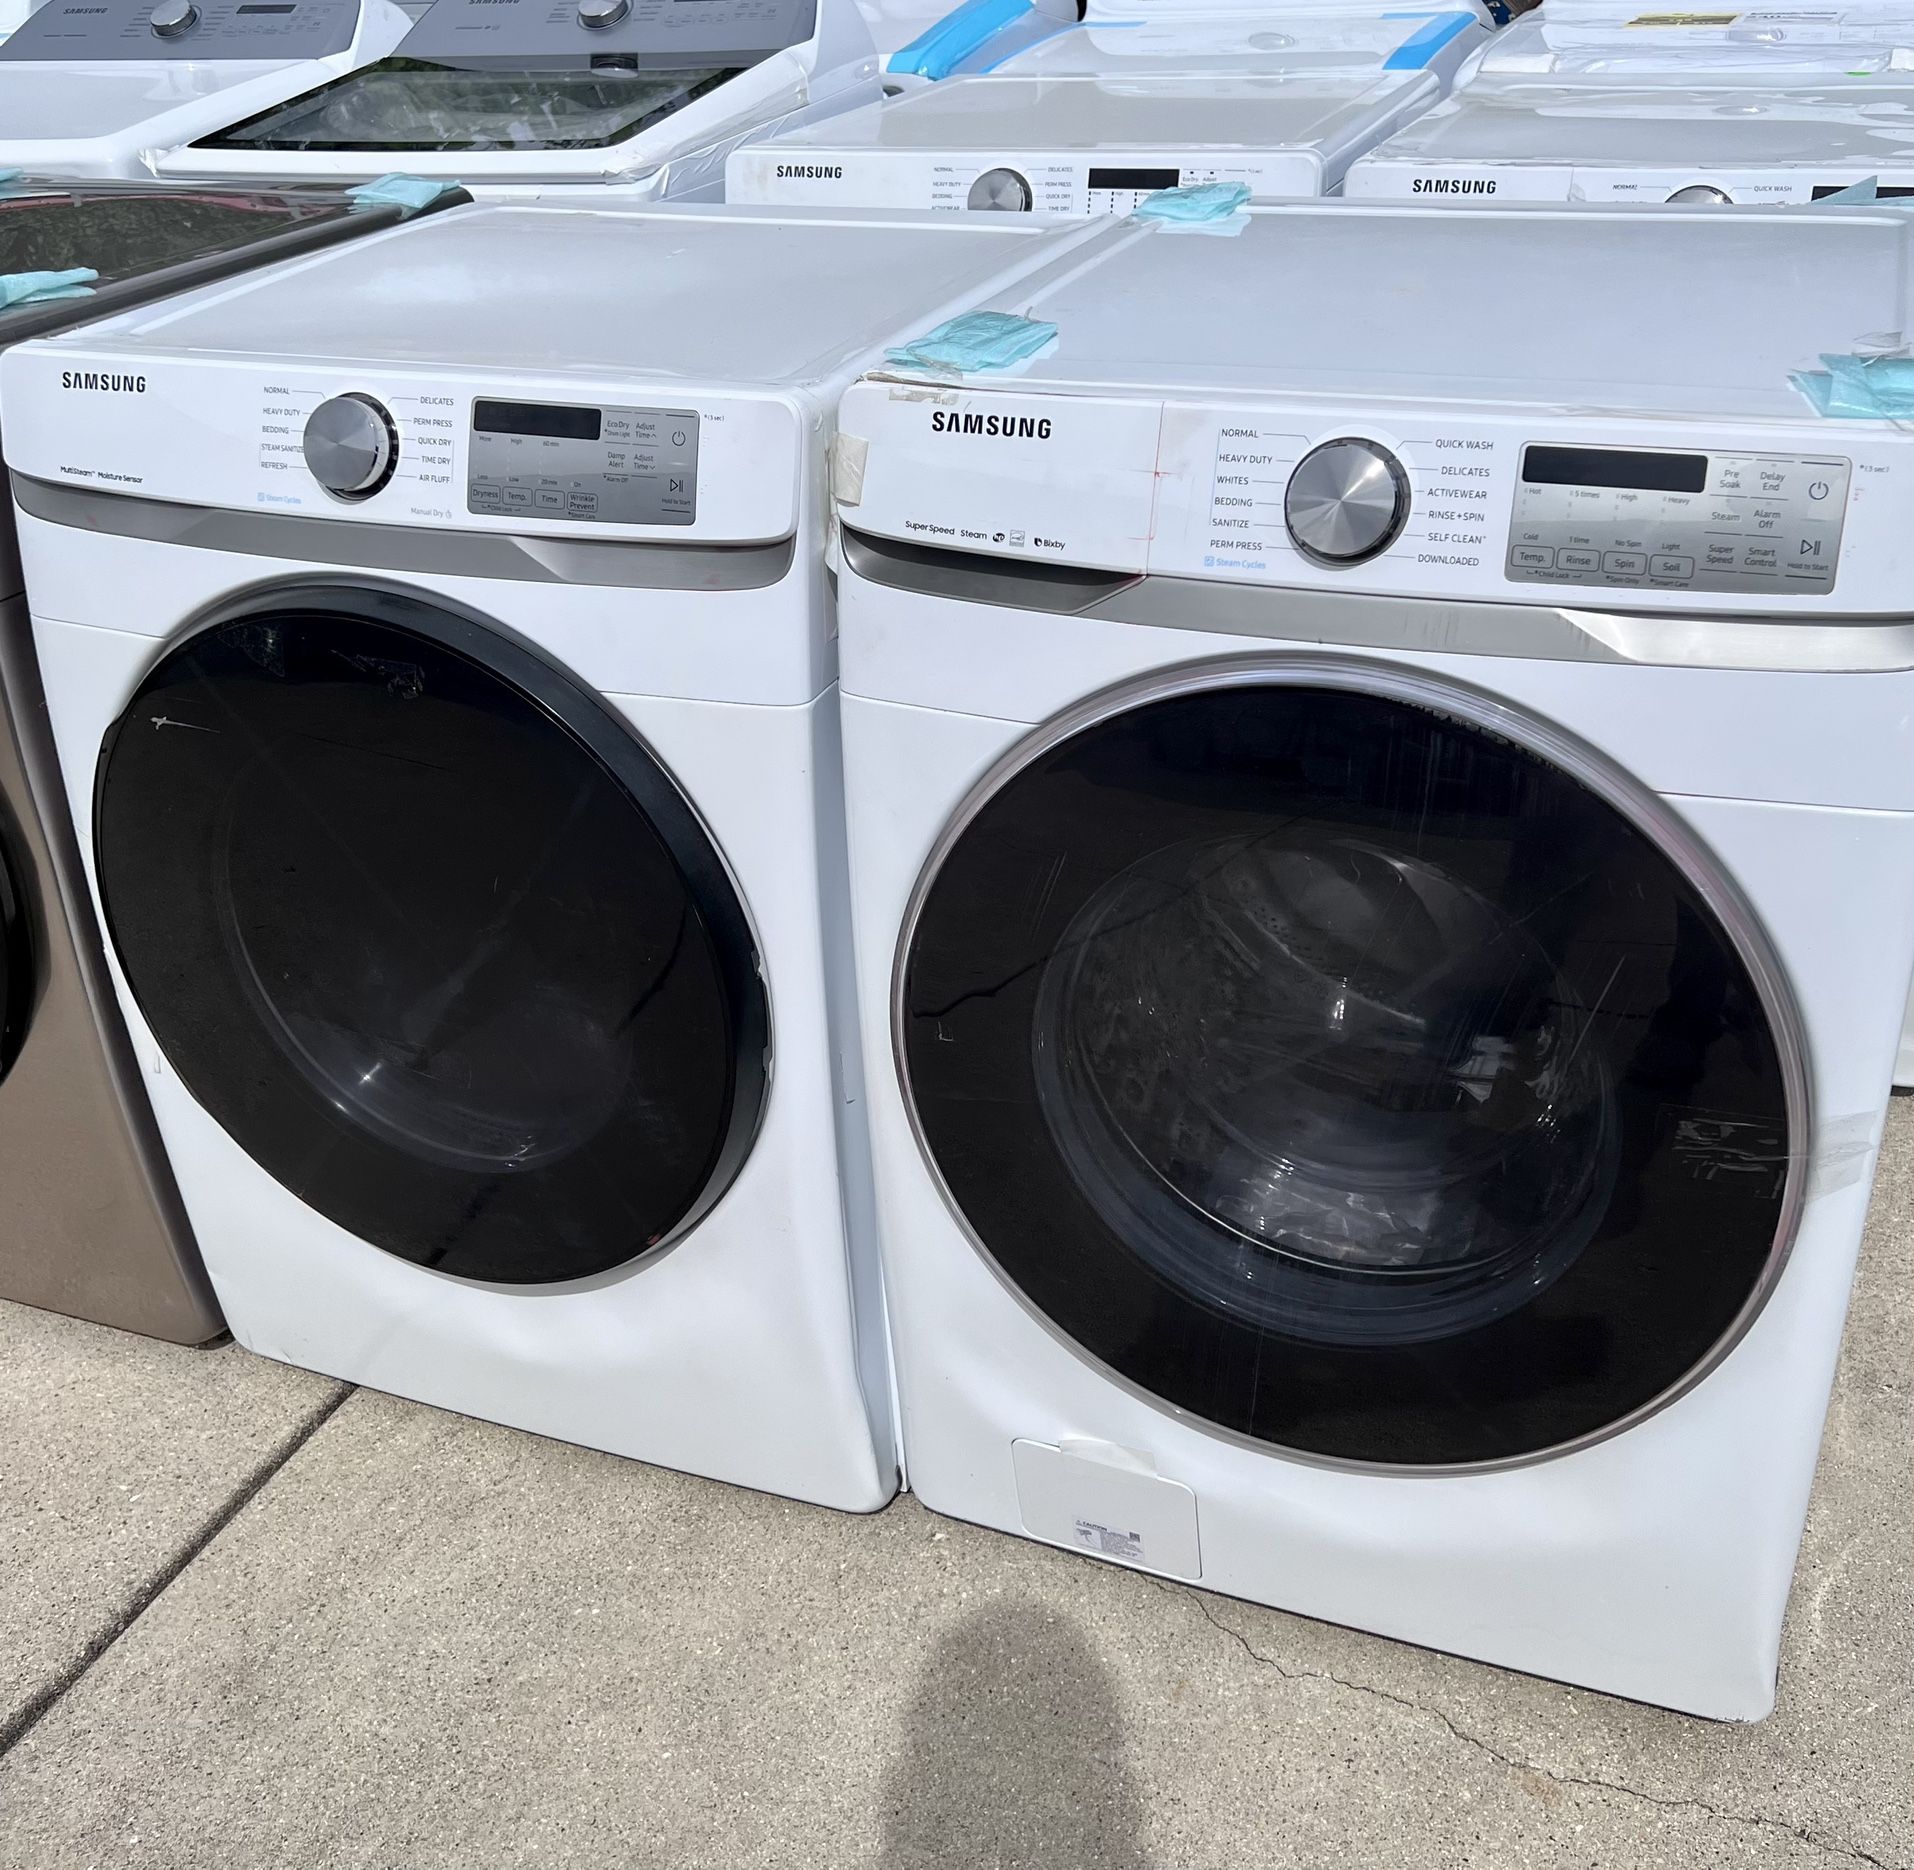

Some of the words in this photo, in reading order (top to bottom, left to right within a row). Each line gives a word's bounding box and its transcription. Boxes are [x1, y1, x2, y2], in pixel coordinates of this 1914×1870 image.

[776, 165, 843, 179] SAMSUNG
[1412, 179, 1496, 194] SAMSUNG
[62, 371, 146, 393] SAMSUNG
[420, 396, 454, 406] DELICATES
[414, 418, 431, 426] PERM
[433, 419, 452, 428] PRESS
[636, 422, 655, 432] Adjust
[932, 411, 1051, 439] SAMSUNG
[262, 425, 289, 434] BEDDING
[1221, 429, 1259, 438] NORMAL
[635, 431, 650, 439] Time
[418, 437, 437, 446] QUICK
[438, 438, 451, 446] DRY
[1435, 439, 1464, 448] QUICK
[1466, 441, 1494, 450] WASH
[261, 443, 280, 451] STEAM
[421, 456, 436, 464] TIME
[437, 457, 451, 465] DRY
[608, 452, 625, 460] Damp
[634, 454, 654, 462] Adjust
[1219, 454, 1248, 463] HEAVY
[1249, 455, 1273, 464] DUTY
[261, 461, 288, 470] REFRESH
[608, 460, 624, 468] Alert
[634, 462, 649, 470] Time
[1441, 466, 1490, 477] DELICATES
[1724, 470, 1739, 478] Pre
[98, 471, 122, 481] Moisture
[123, 475, 143, 484] Sensor
[419, 474, 430, 482] AIR
[431, 476, 450, 484] FLUFF
[1217, 476, 1249, 485] WHITES
[1760, 472, 1786, 483] Delay
[1720, 480, 1741, 488] Soak
[1763, 482, 1780, 491] End
[473, 489, 498, 499] Dryness
[508, 492, 526, 501] Temp.
[541, 494, 558, 503] Time
[570, 494, 595, 502] Wrinkle
[1427, 488, 1487, 499] ACTIVEWEAR
[1580, 491, 1600, 499] times
[1621, 493, 1638, 501] High
[1214, 497, 1253, 507] BEDDING
[1668, 496, 1690, 505] Heavy
[569, 502, 595, 510] Prevent
[411, 507, 432, 516] Manual
[433, 509, 443, 519] Dry
[1428, 511, 1455, 520] RINSE
[1463, 512, 1484, 521] SPIN
[1712, 512, 1741, 522] Steam
[1754, 510, 1781, 519] Alarm
[1212, 518, 1249, 528] SANITIZE
[1759, 520, 1774, 528] Off
[960, 529, 987, 540] Steam
[1044, 539, 1065, 550] Bixby
[1428, 533, 1449, 541] SELF
[1210, 540, 1233, 549] PERM
[1236, 541, 1262, 550] PRESS
[1709, 545, 1735, 554] Super
[1520, 551, 1546, 563] Temp.
[1748, 547, 1775, 557] Smart
[1216, 558, 1240, 567] Steam
[1242, 559, 1266, 569] Cycles
[1418, 554, 1480, 566] DOWNLOADED
[1566, 555, 1591, 566] Rinse
[1614, 559, 1635, 569] Spin
[1706, 555, 1734, 565] Speed
[1744, 557, 1777, 568] Control
[1663, 562, 1680, 572] Soil
